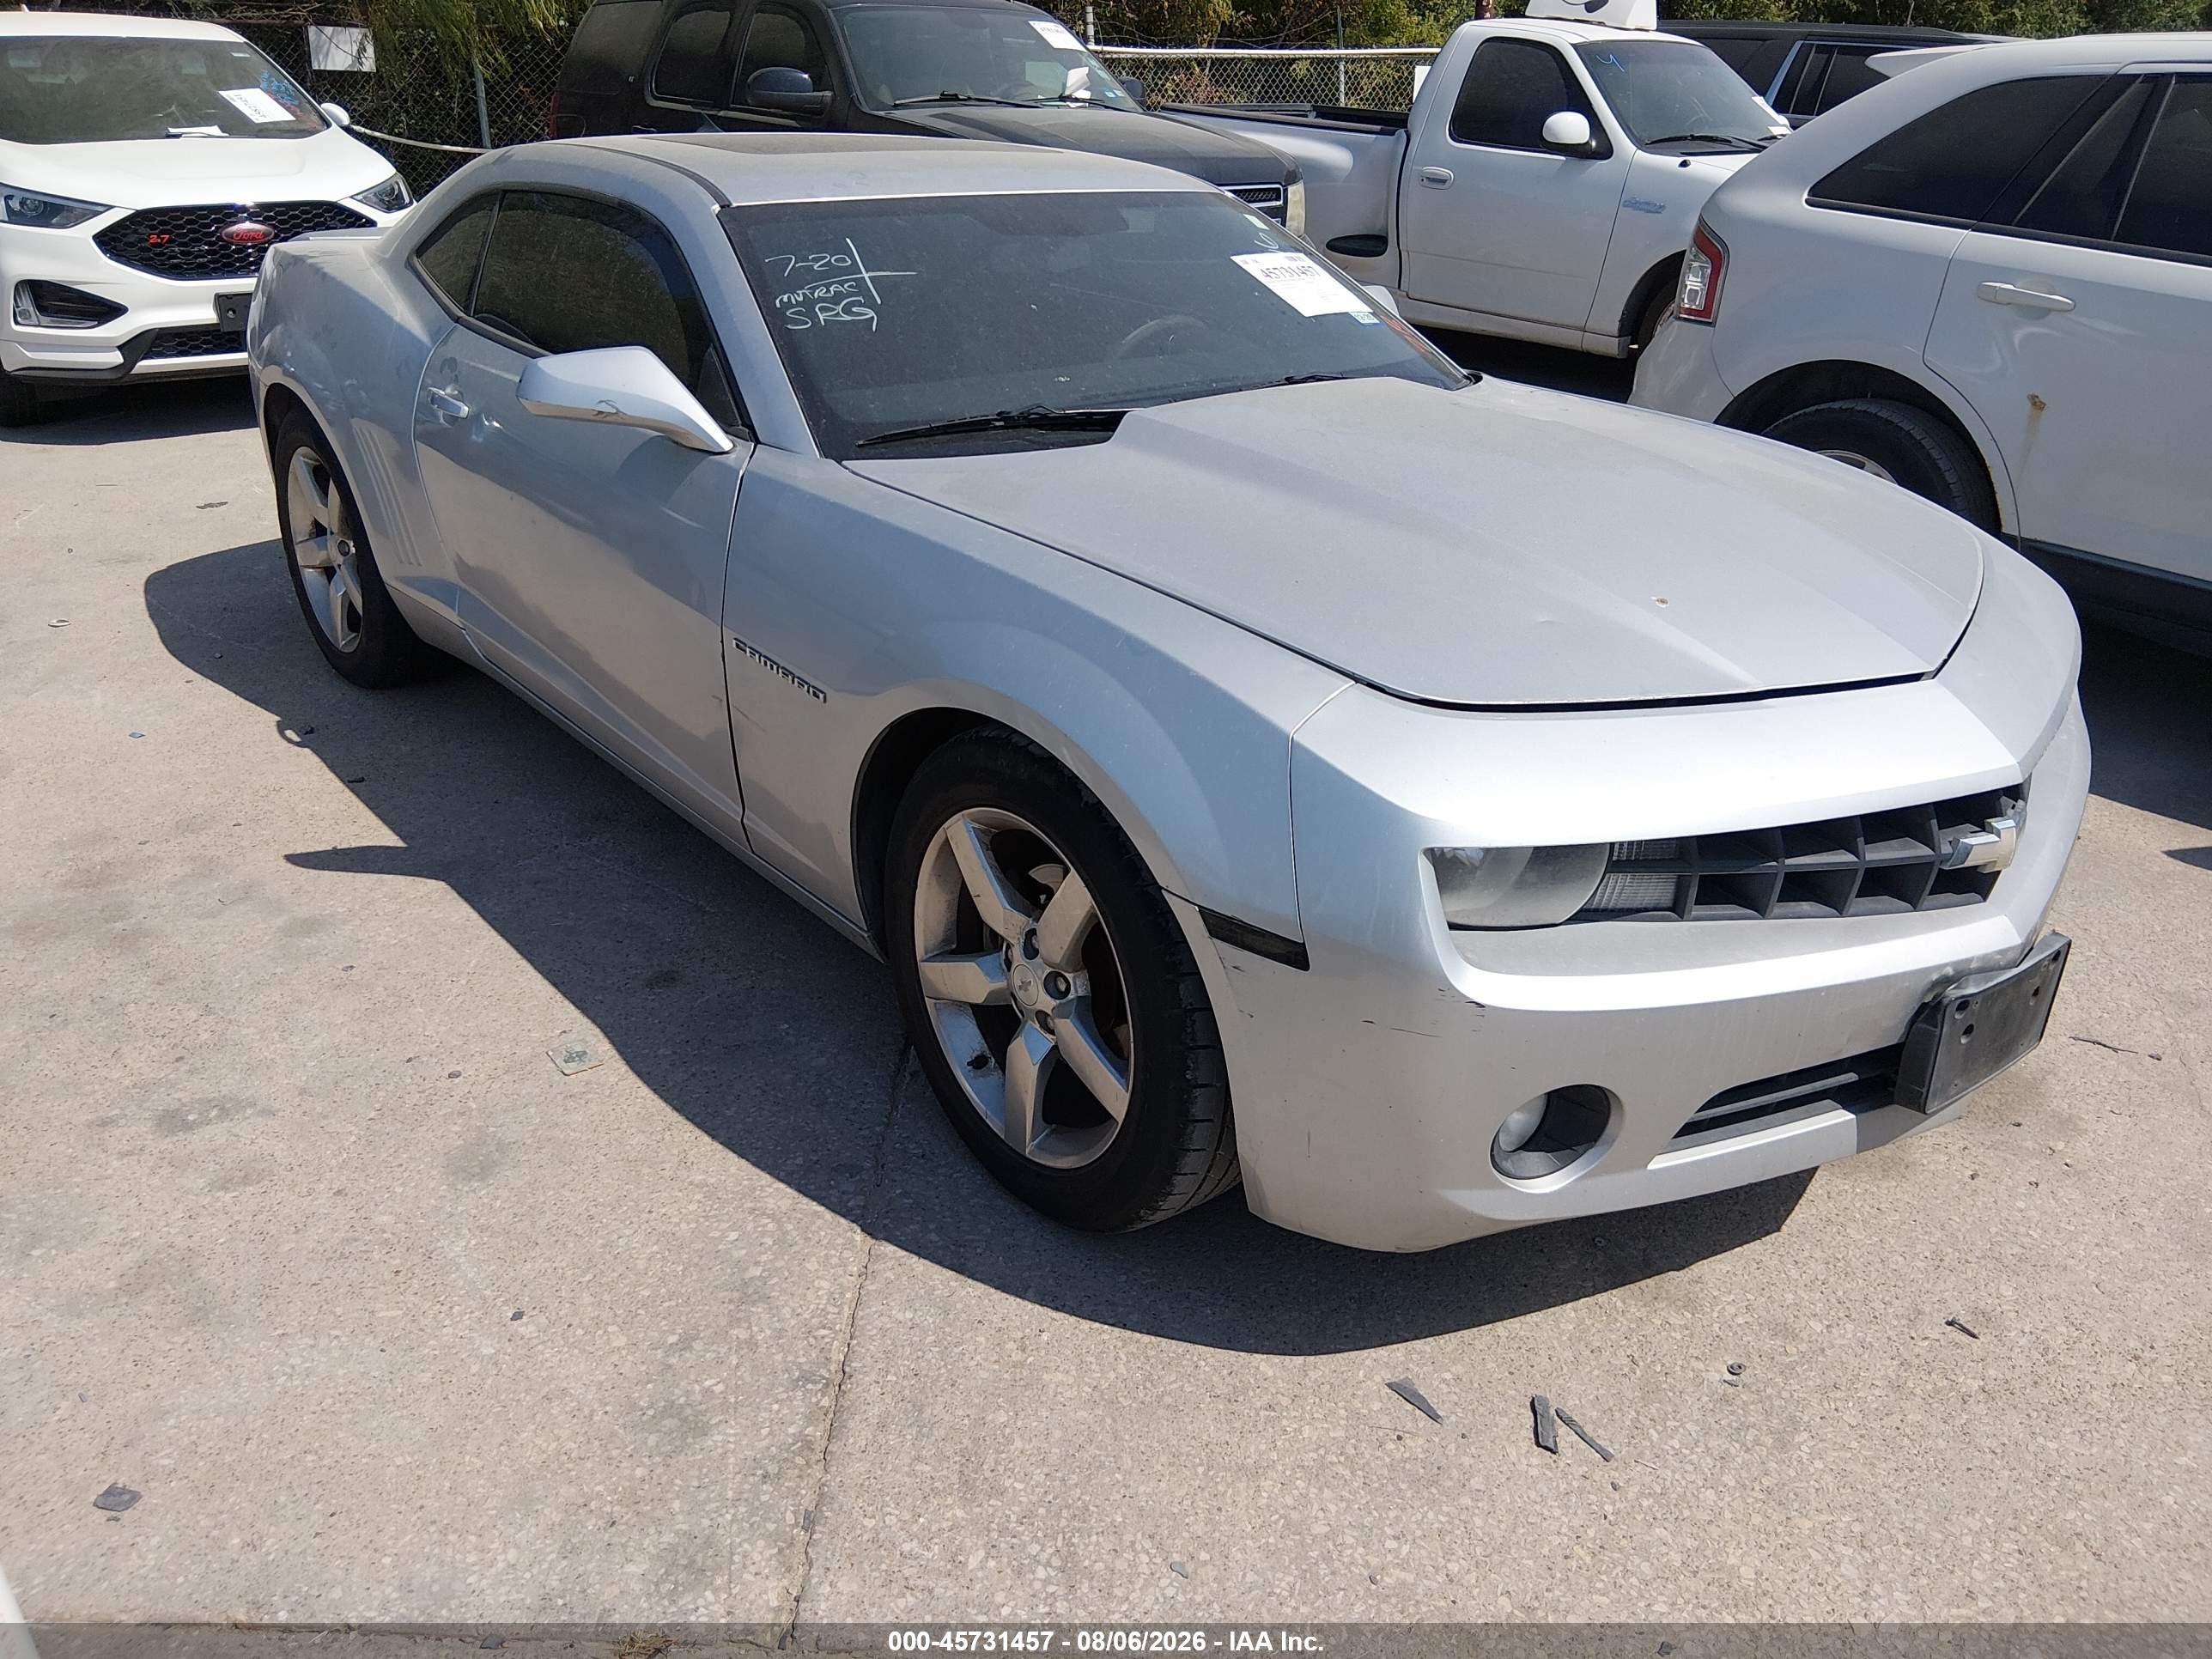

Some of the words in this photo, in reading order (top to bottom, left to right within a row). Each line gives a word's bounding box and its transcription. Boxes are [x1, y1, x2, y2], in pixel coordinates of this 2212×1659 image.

[149, 234, 170, 244] 2.7
[233, 228, 264, 240] Ford
[1258, 264, 1322, 281] 45731457
